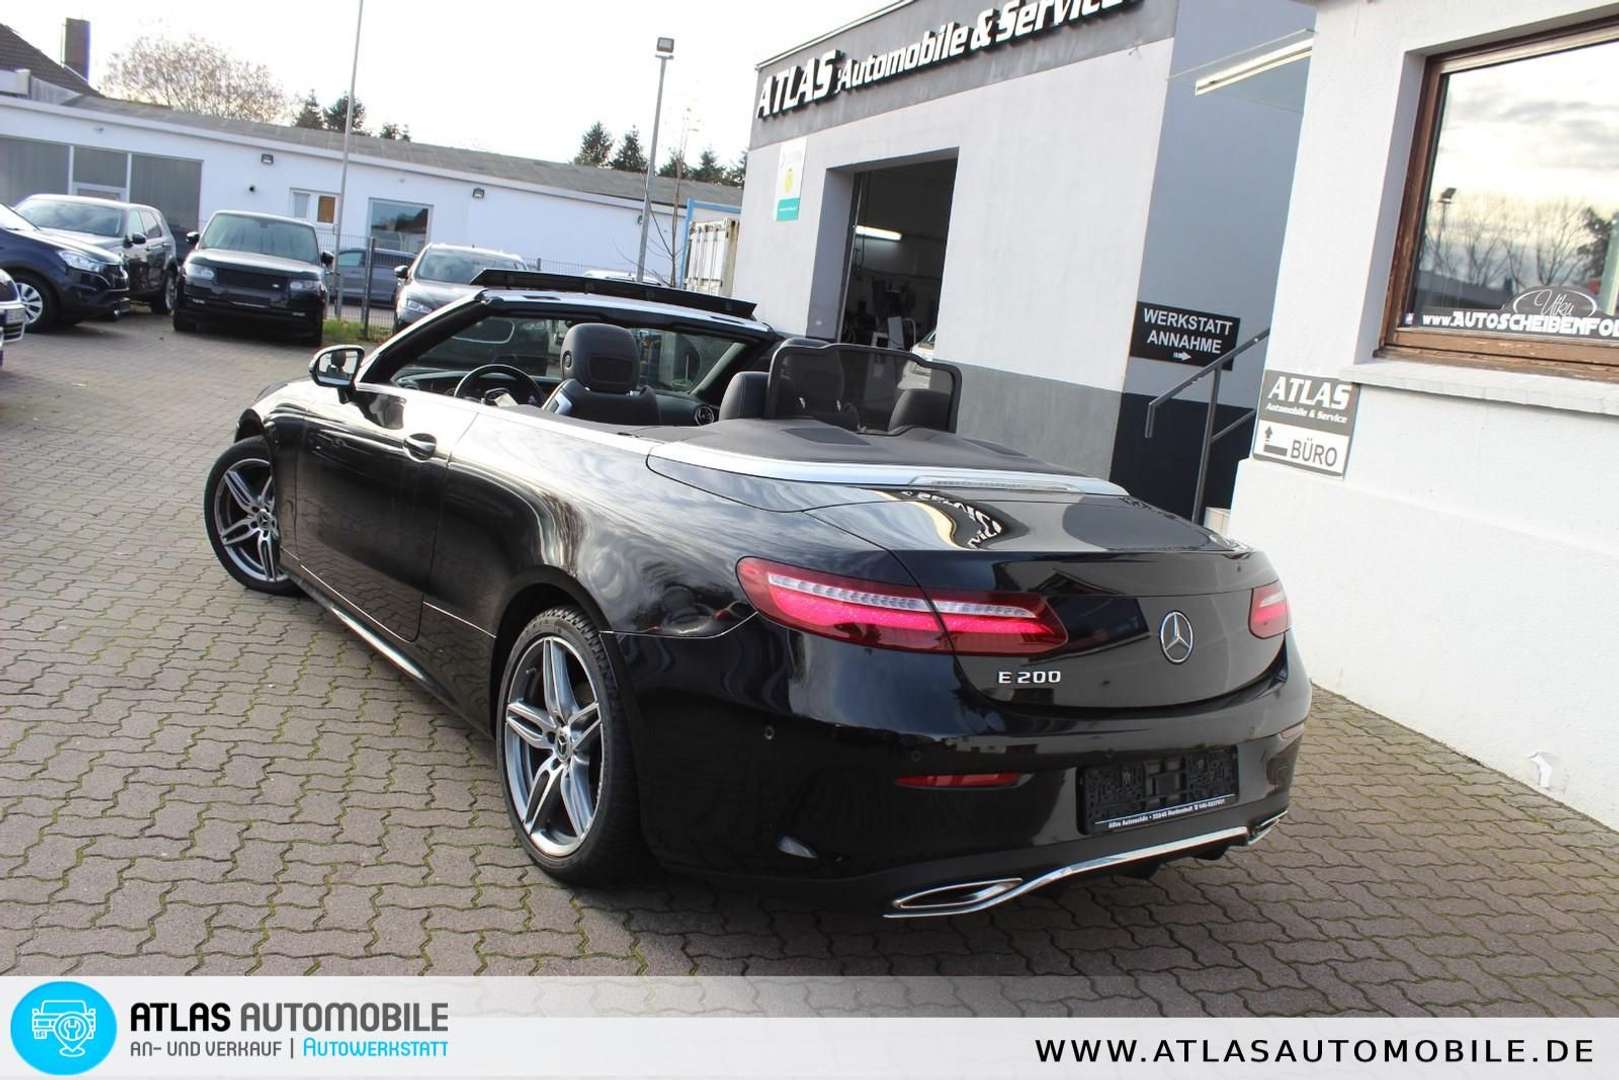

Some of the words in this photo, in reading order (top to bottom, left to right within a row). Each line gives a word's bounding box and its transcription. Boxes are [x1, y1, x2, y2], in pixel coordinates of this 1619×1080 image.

[756, 49, 837, 119] ATLAS
[834, 21, 969, 94] Automobile
[970, 8, 994, 51] &
[1144, 308, 1233, 336] WERKSTATT
[1147, 330, 1222, 354] ANNAHME
[1267, 376, 1353, 411] ATLAS
[1317, 411, 1348, 424] Service
[1290, 437, 1338, 467] BÜRO
[998, 670, 1012, 684] E
[1017, 670, 1062, 684] 200
